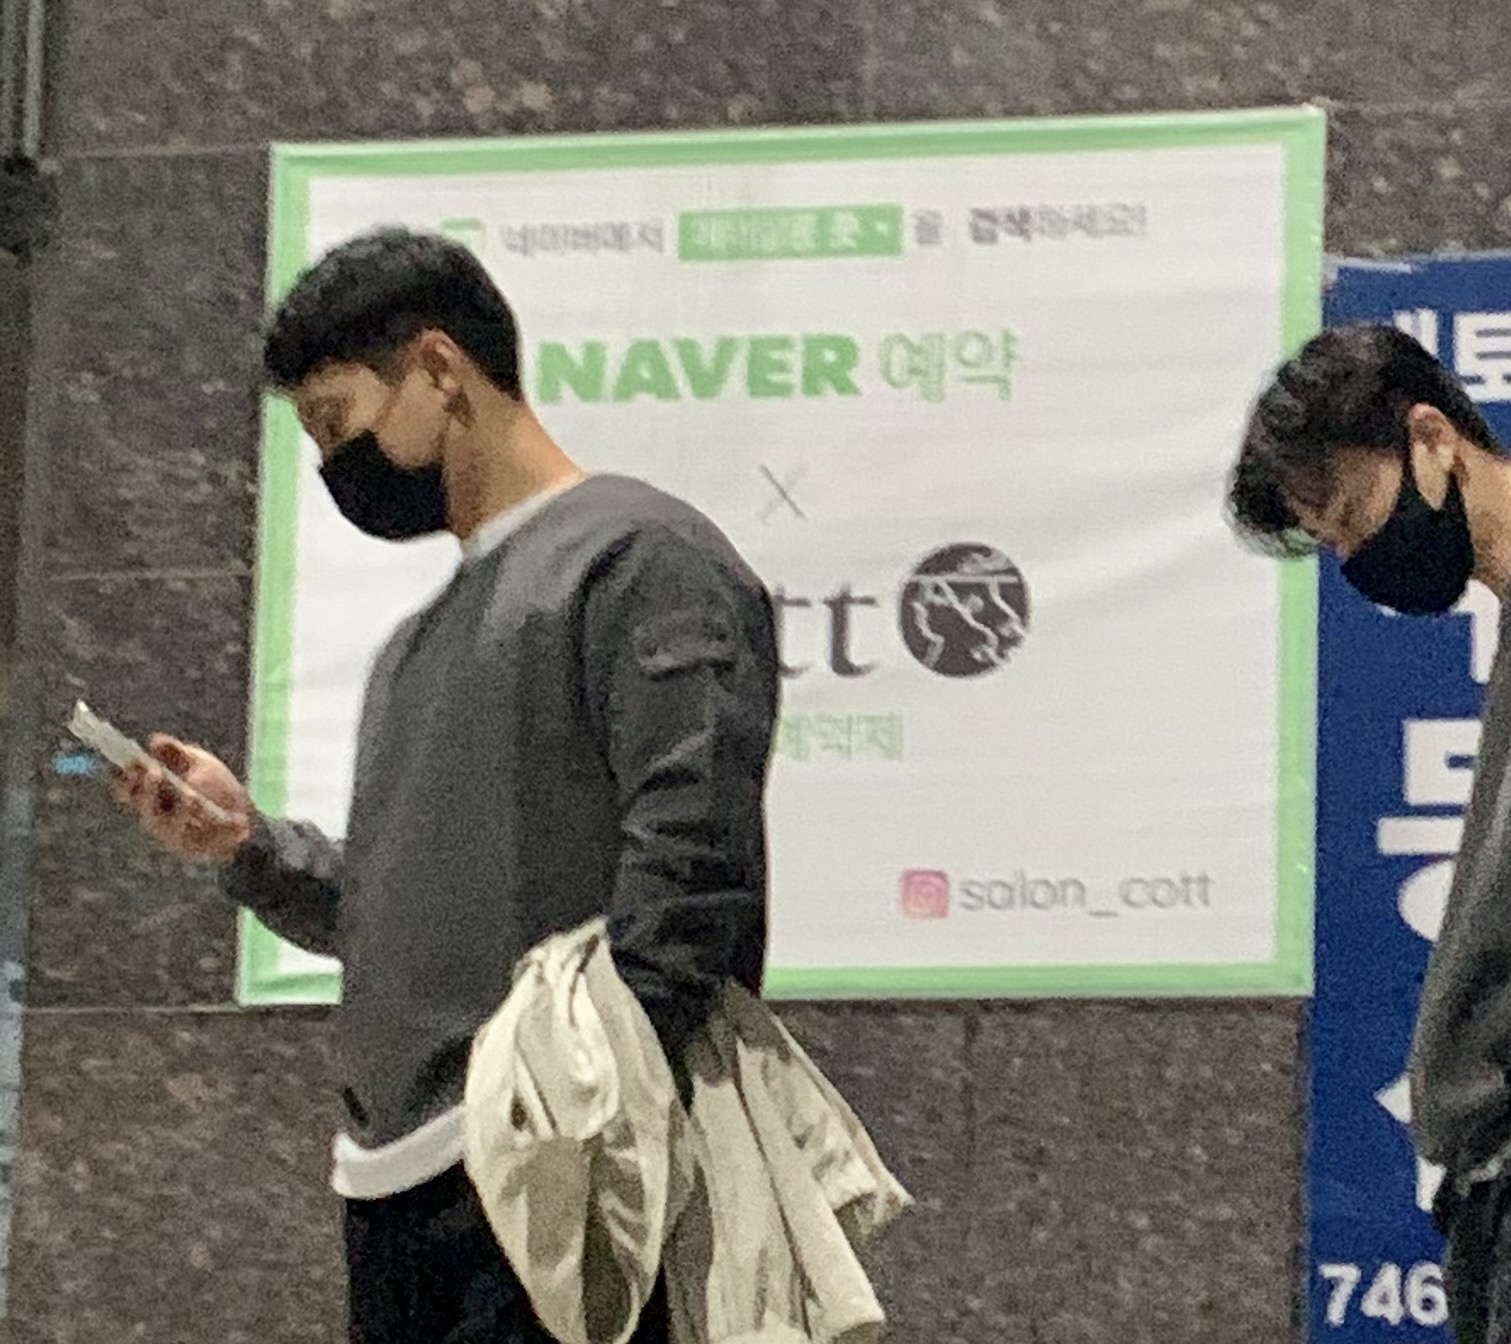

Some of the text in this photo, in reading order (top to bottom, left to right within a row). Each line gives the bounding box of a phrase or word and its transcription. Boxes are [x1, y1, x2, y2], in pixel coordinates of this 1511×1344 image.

[537, 327, 1019, 404] NAVER 예약
[958, 869, 1215, 919] salon_cott
